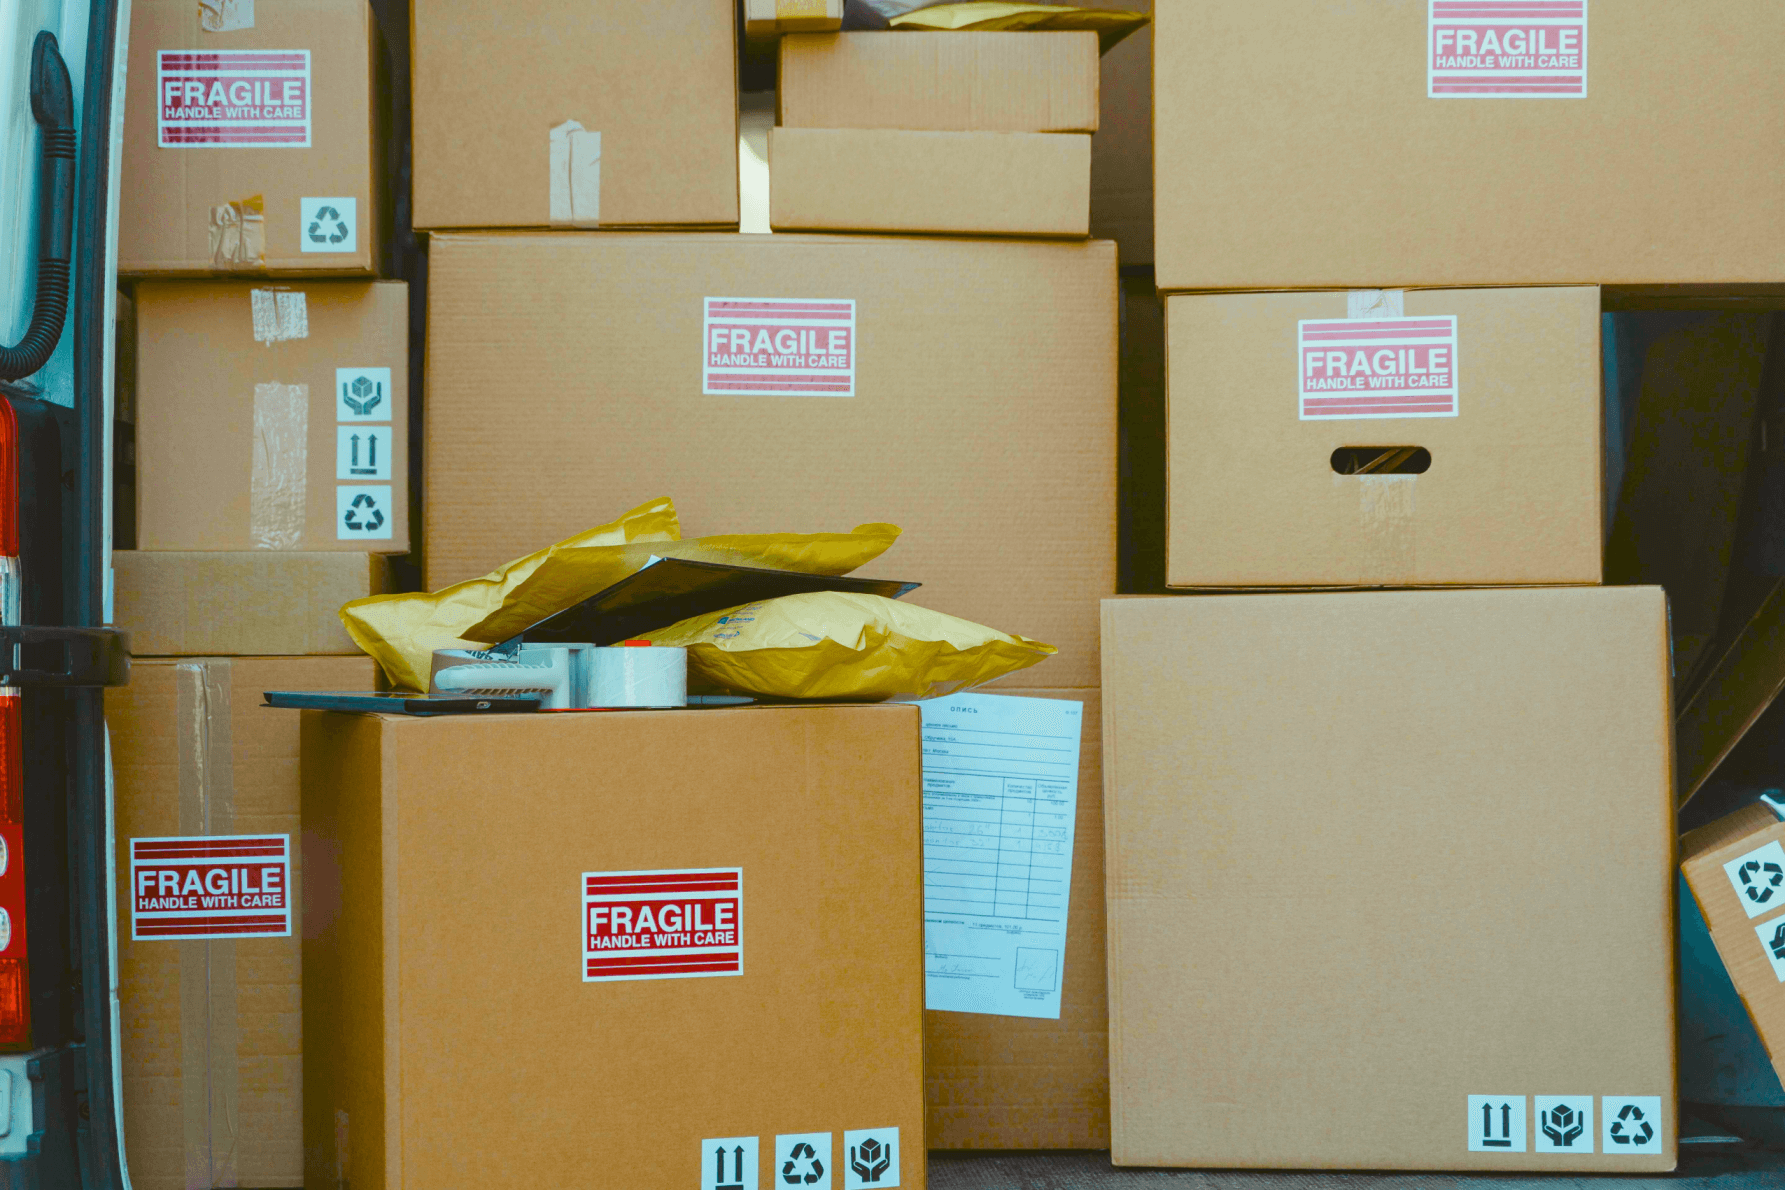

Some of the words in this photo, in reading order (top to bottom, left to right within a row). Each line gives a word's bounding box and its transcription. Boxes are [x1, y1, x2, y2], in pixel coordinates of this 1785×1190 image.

[1437, 29, 1579, 55] FRAGILE
[1437, 56, 1495, 68] HANDLE
[1498, 56, 1535, 68] WITH
[1538, 56, 1579, 68] CARE
[165, 81, 304, 106] FRAGILE
[166, 107, 223, 119] HANDLE
[225, 107, 261, 119] WITH
[264, 107, 303, 119] CARE
[711, 328, 848, 354] FRAGILE
[711, 354, 767, 366] HANDLE
[771, 354, 806, 367] WITH
[809, 355, 847, 368] CARE
[1305, 348, 1449, 377] FRAGILE
[1306, 376, 1366, 390] HANDLE
[1367, 376, 1405, 389] WITH
[1408, 375, 1449, 388] CARE
[950, 706, 978, 714] ОПИСЬ
[139, 868, 282, 897] FRAGILE
[140, 897, 198, 910] HANDLE
[200, 896, 238, 909] WITH
[240, 895, 282, 908] CARE
[589, 903, 735, 935] FRAGILE
[590, 934, 651, 949] HANDLE
[653, 933, 691, 947] WITH
[694, 931, 735, 946] CARE
